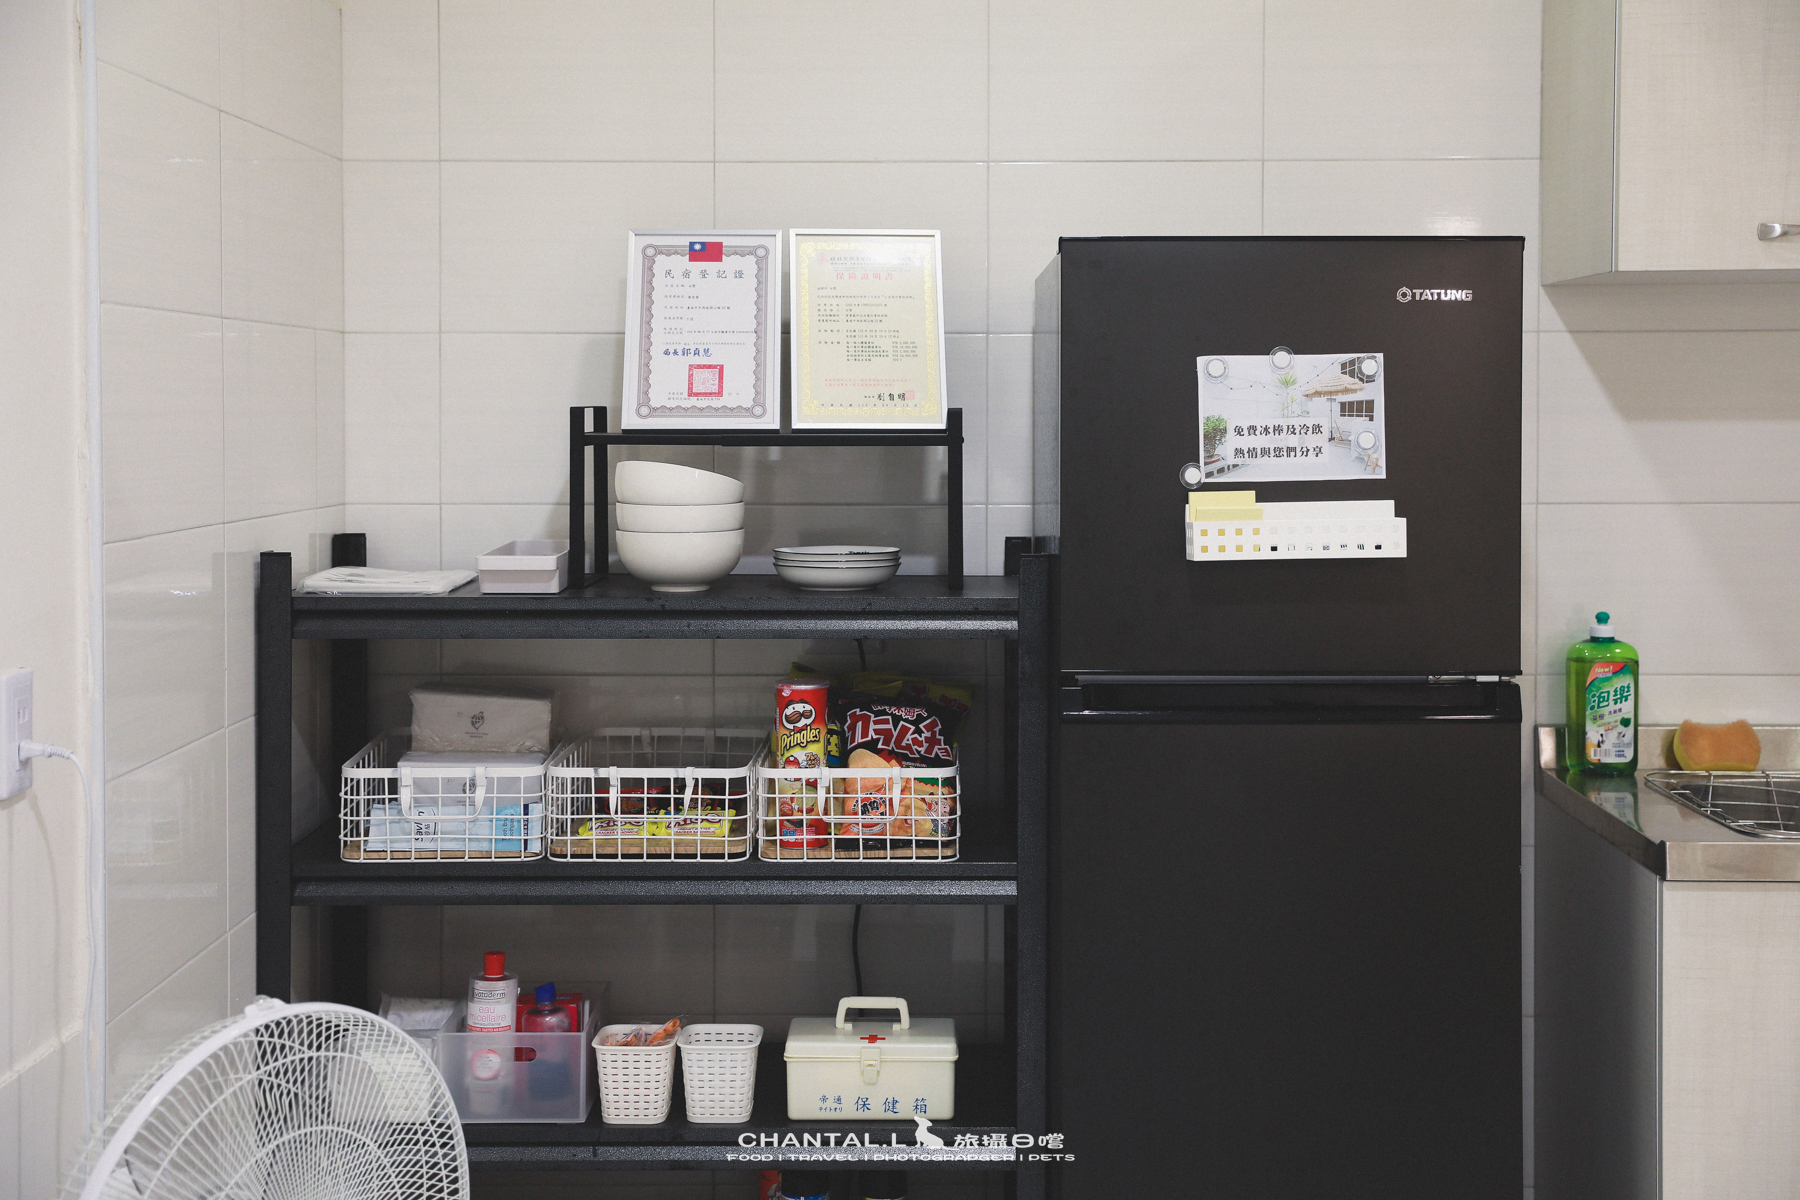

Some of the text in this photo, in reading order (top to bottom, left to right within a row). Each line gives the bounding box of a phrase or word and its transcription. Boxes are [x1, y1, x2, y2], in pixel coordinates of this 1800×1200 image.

[664, 268, 745, 280] 民宿登記證
[836, 272, 894, 281] 保險證明書
[1412, 289, 1473, 302] TATUNG
[1233, 423, 1324, 437] 免費冰棒及冷飲
[1233, 445, 1324, 459] 熱情與您們分享
[1589, 682, 1632, 711] 泡樂
[781, 725, 820, 756] Pringles
[413, 811, 425, 842] Savln
[478, 1006, 496, 1014] eau
[469, 1012, 507, 1022] micellaire
[819, 1094, 843, 1105] 帝通
[853, 1096, 928, 1115] 保健箱
